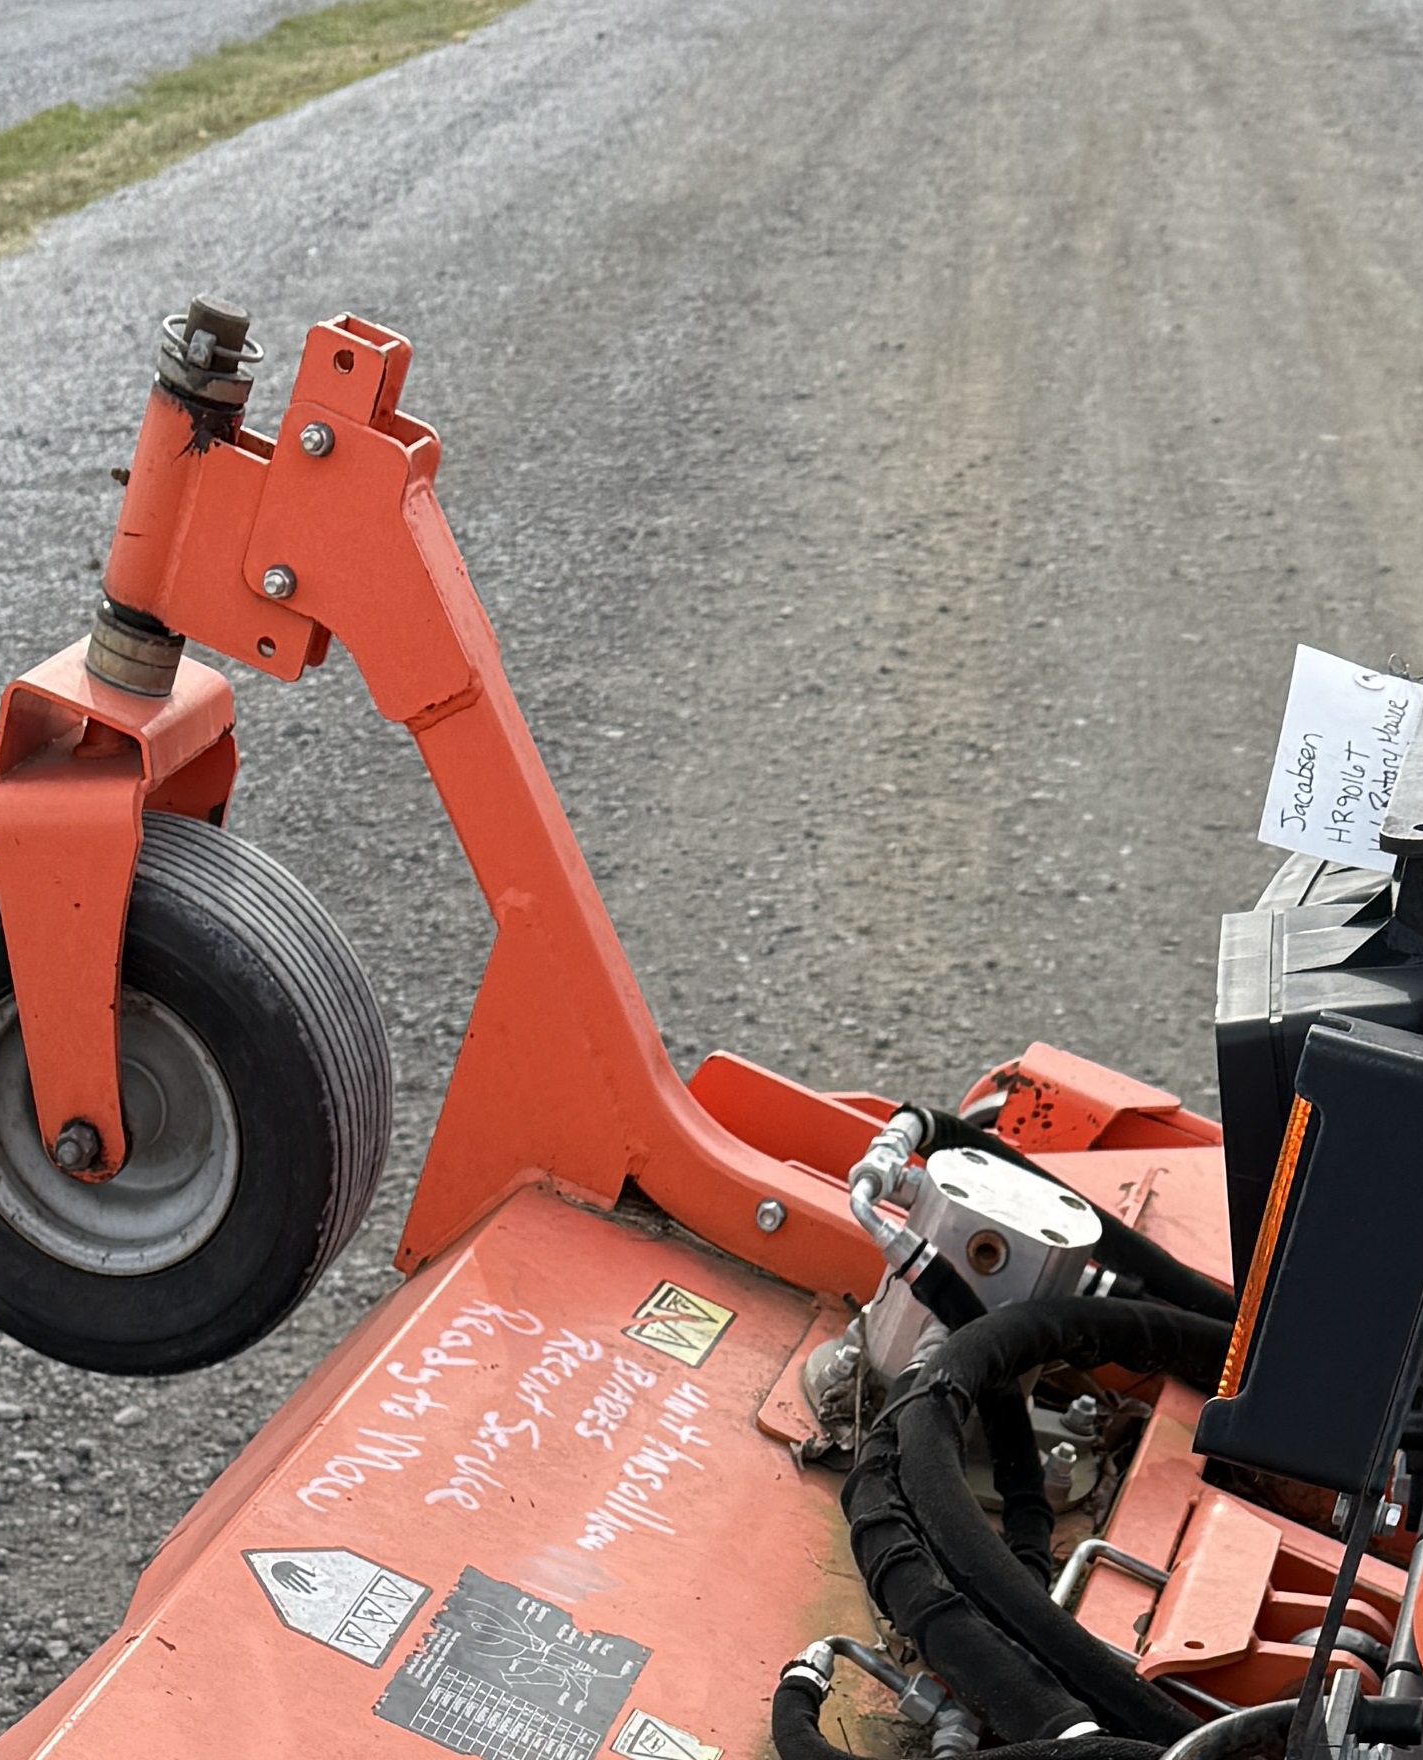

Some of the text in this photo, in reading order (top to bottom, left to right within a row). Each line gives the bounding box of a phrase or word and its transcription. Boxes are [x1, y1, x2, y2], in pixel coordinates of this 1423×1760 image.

[1324, 740, 1369, 844] HR9016T
[296, 1300, 544, 1513] Ready to Mow
[516, 1328, 604, 1418] Recent
